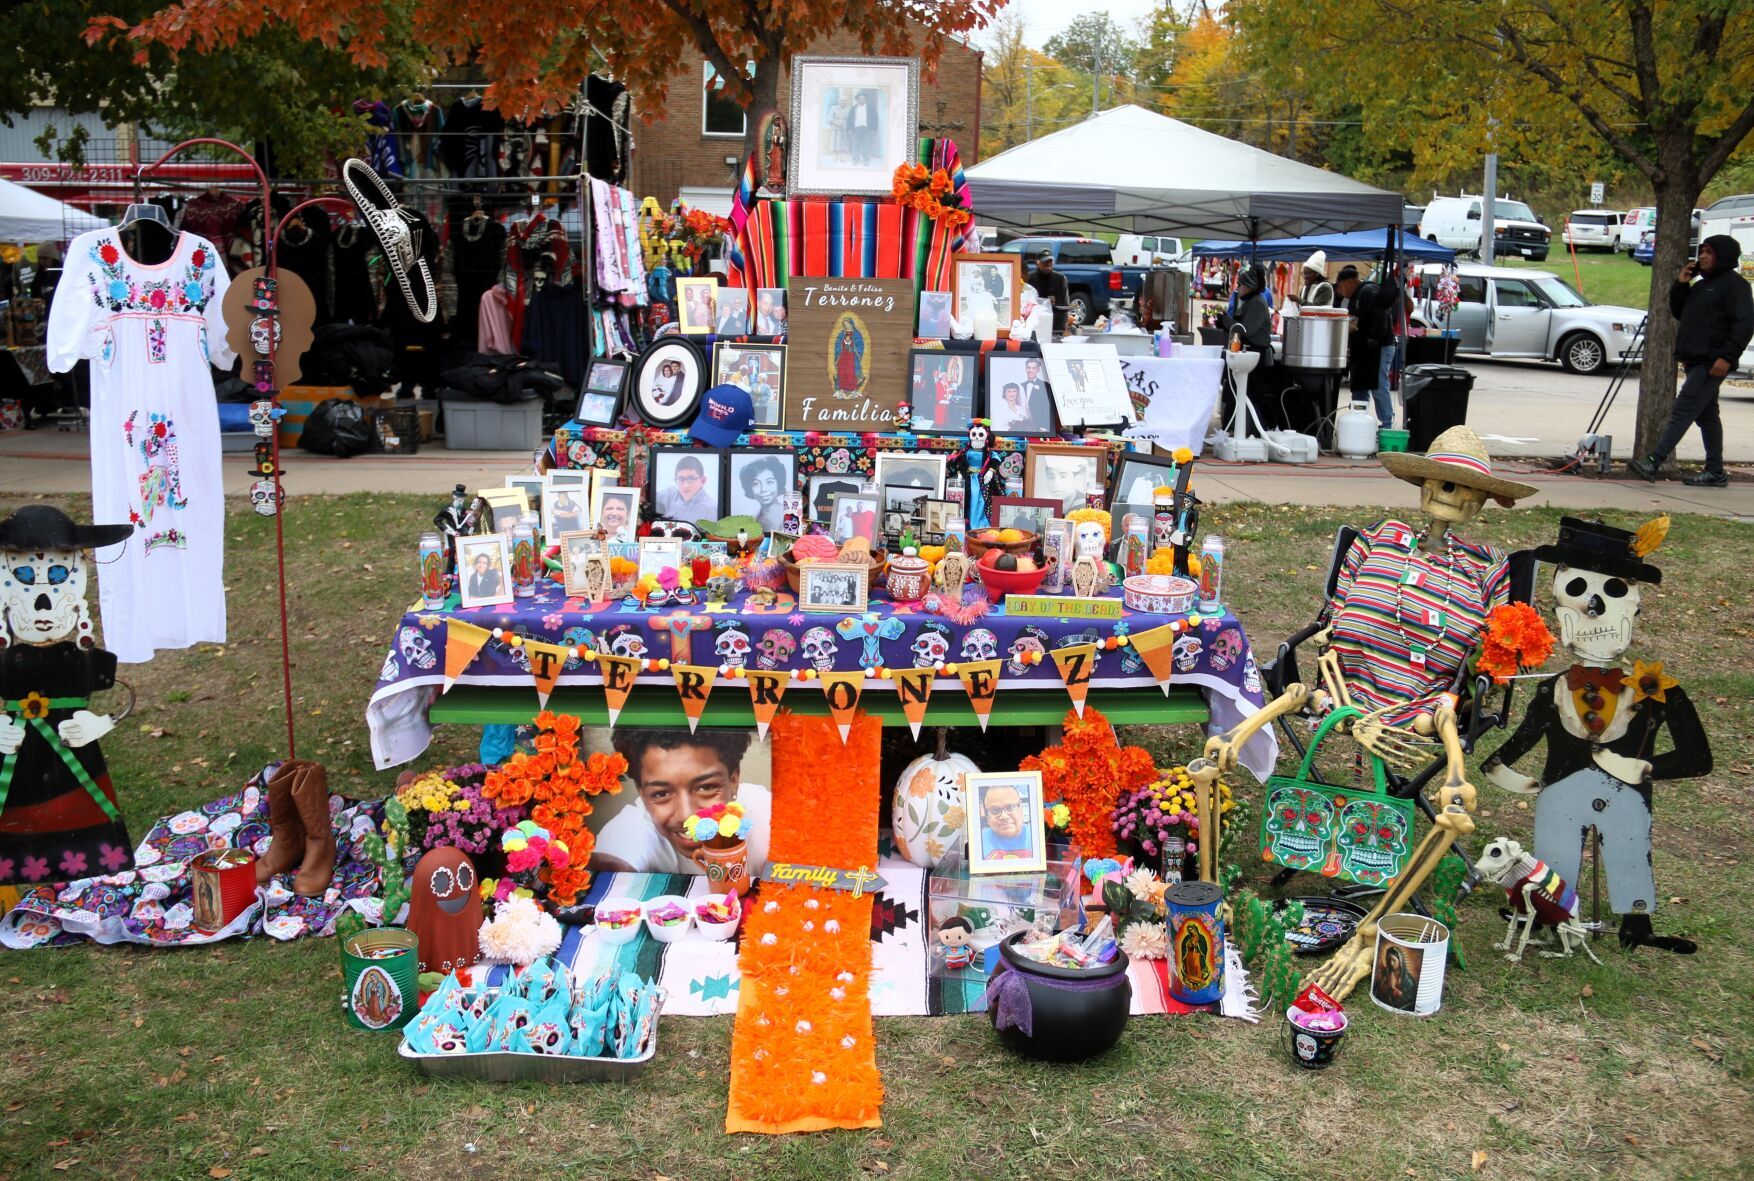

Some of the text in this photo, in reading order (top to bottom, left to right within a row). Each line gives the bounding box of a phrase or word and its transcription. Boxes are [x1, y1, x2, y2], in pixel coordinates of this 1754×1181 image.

[1592, 193, 1602, 201] 30
[823, 283, 848, 292] Benito
[850, 284, 856, 292] &
[804, 287, 895, 312] Terronez
[708, 397, 735, 414] WORLD
[802, 397, 893, 422] Familia
[609, 545, 623, 556] AY
[1014, 601, 1115, 616] DAY OF THE DEAD
[770, 863, 837, 888] Family
